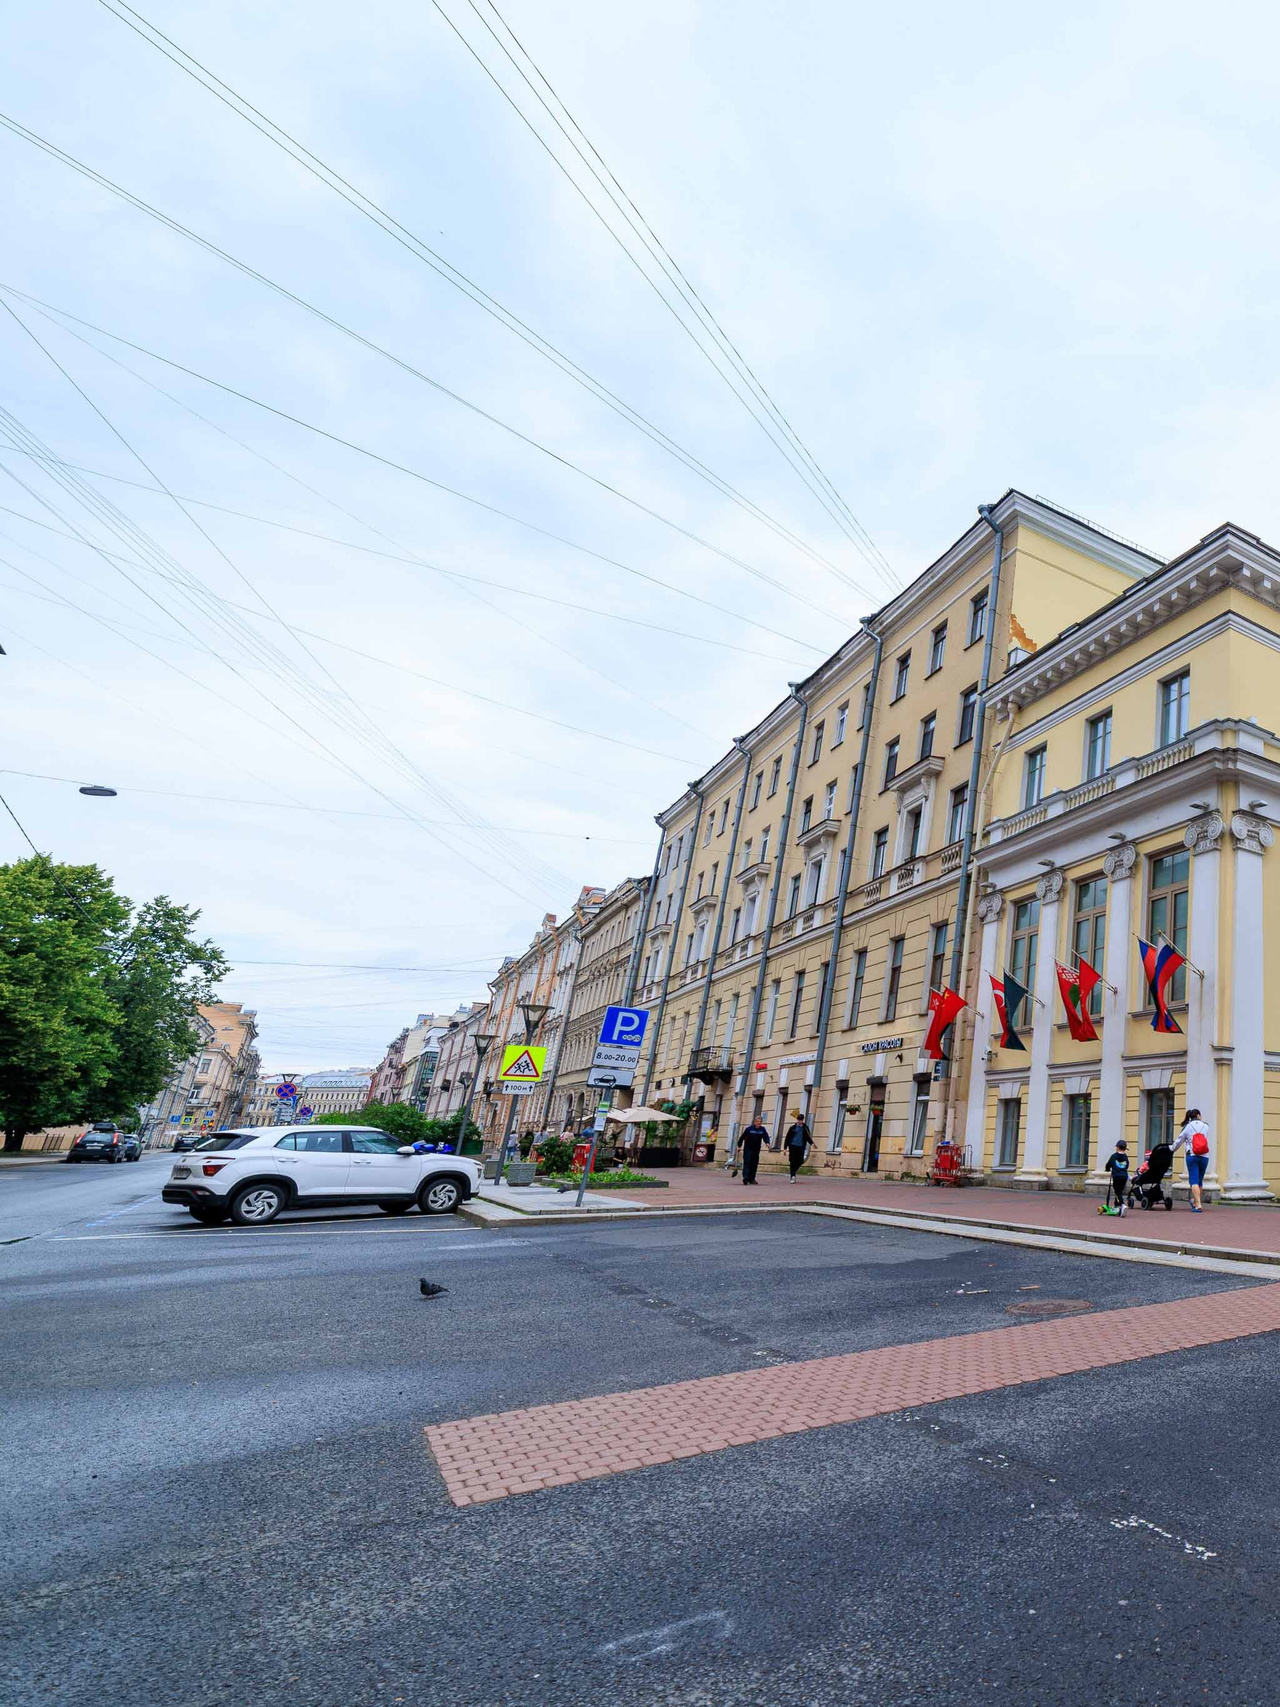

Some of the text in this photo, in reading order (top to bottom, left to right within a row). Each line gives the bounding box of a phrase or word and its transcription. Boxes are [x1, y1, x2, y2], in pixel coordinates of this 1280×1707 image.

[612, 1011, 640, 1041] P
[861, 1038, 904, 1053] САЛОН КРАСОТЫ
[596, 1052, 637, 1063] 8.00-20.00
